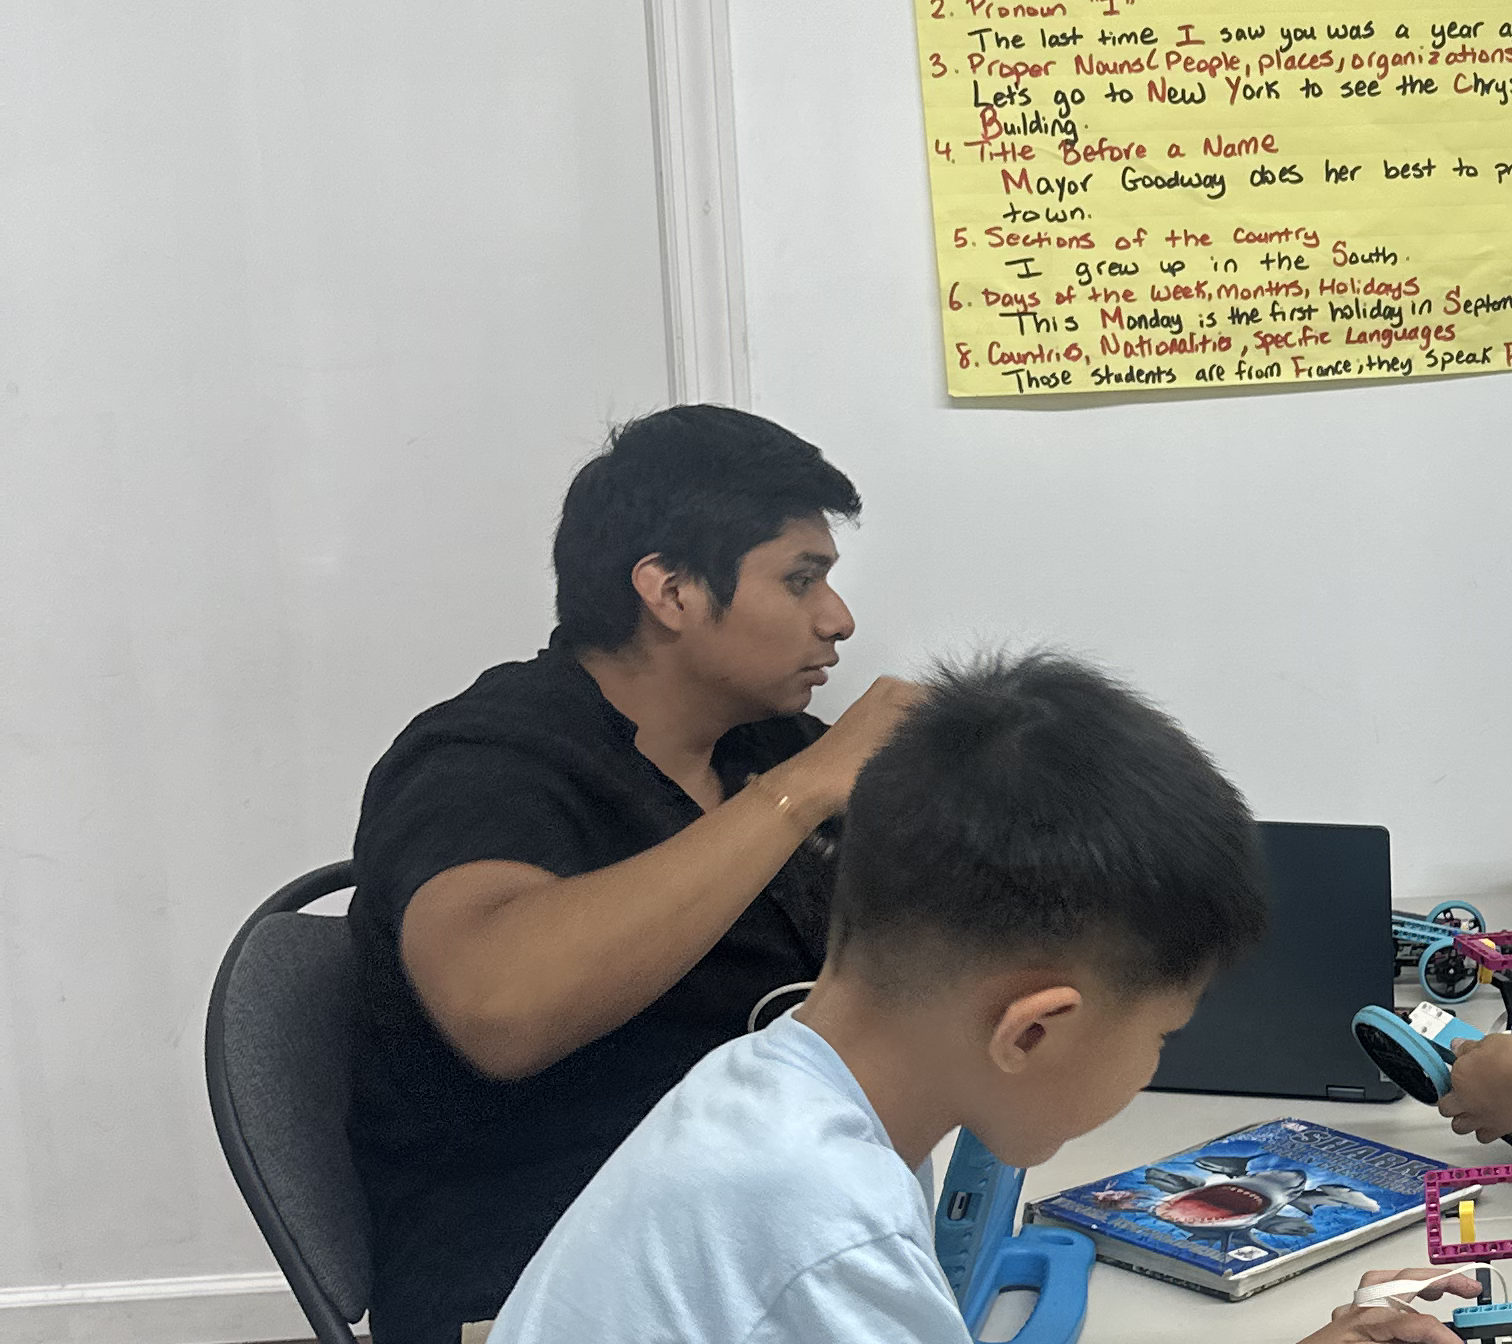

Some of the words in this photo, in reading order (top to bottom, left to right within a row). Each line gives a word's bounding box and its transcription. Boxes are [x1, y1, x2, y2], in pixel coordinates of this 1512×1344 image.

[972, 78, 1032, 113] Let's
[1053, 88, 1085, 119] go
[1104, 82, 1133, 104] to
[1147, 76, 1206, 106] New
[1224, 76, 1280, 106] York
[1299, 78, 1323, 99] to
[1340, 80, 1382, 99] see
[1395, 74, 1438, 96] the
[935, 139, 955, 164] 4.
[963, 135, 1036, 163] Title
[1058, 136, 1147, 167] Before
[1167, 143, 1186, 159] a
[1202, 134, 1279, 159] Name
[1001, 167, 1093, 202] Mayor
[1120, 166, 1226, 200] Goodway
[1324, 159, 1362, 184] her
[1383, 158, 1436, 180] best
[1452, 157, 1478, 178] to
[1003, 202, 1092, 224] town.
[954, 227, 976, 248] 5.
[984, 226, 1095, 250] Sections
[1115, 227, 1148, 251] of
[1165, 229, 1213, 248] the
[1005, 257, 1043, 280] I
[1075, 260, 1140, 286] grew
[1160, 260, 1185, 277] up
[1210, 256, 1238, 273] in
[1260, 251, 1310, 271] the
[1290, 1129, 1439, 1181] SHARK
